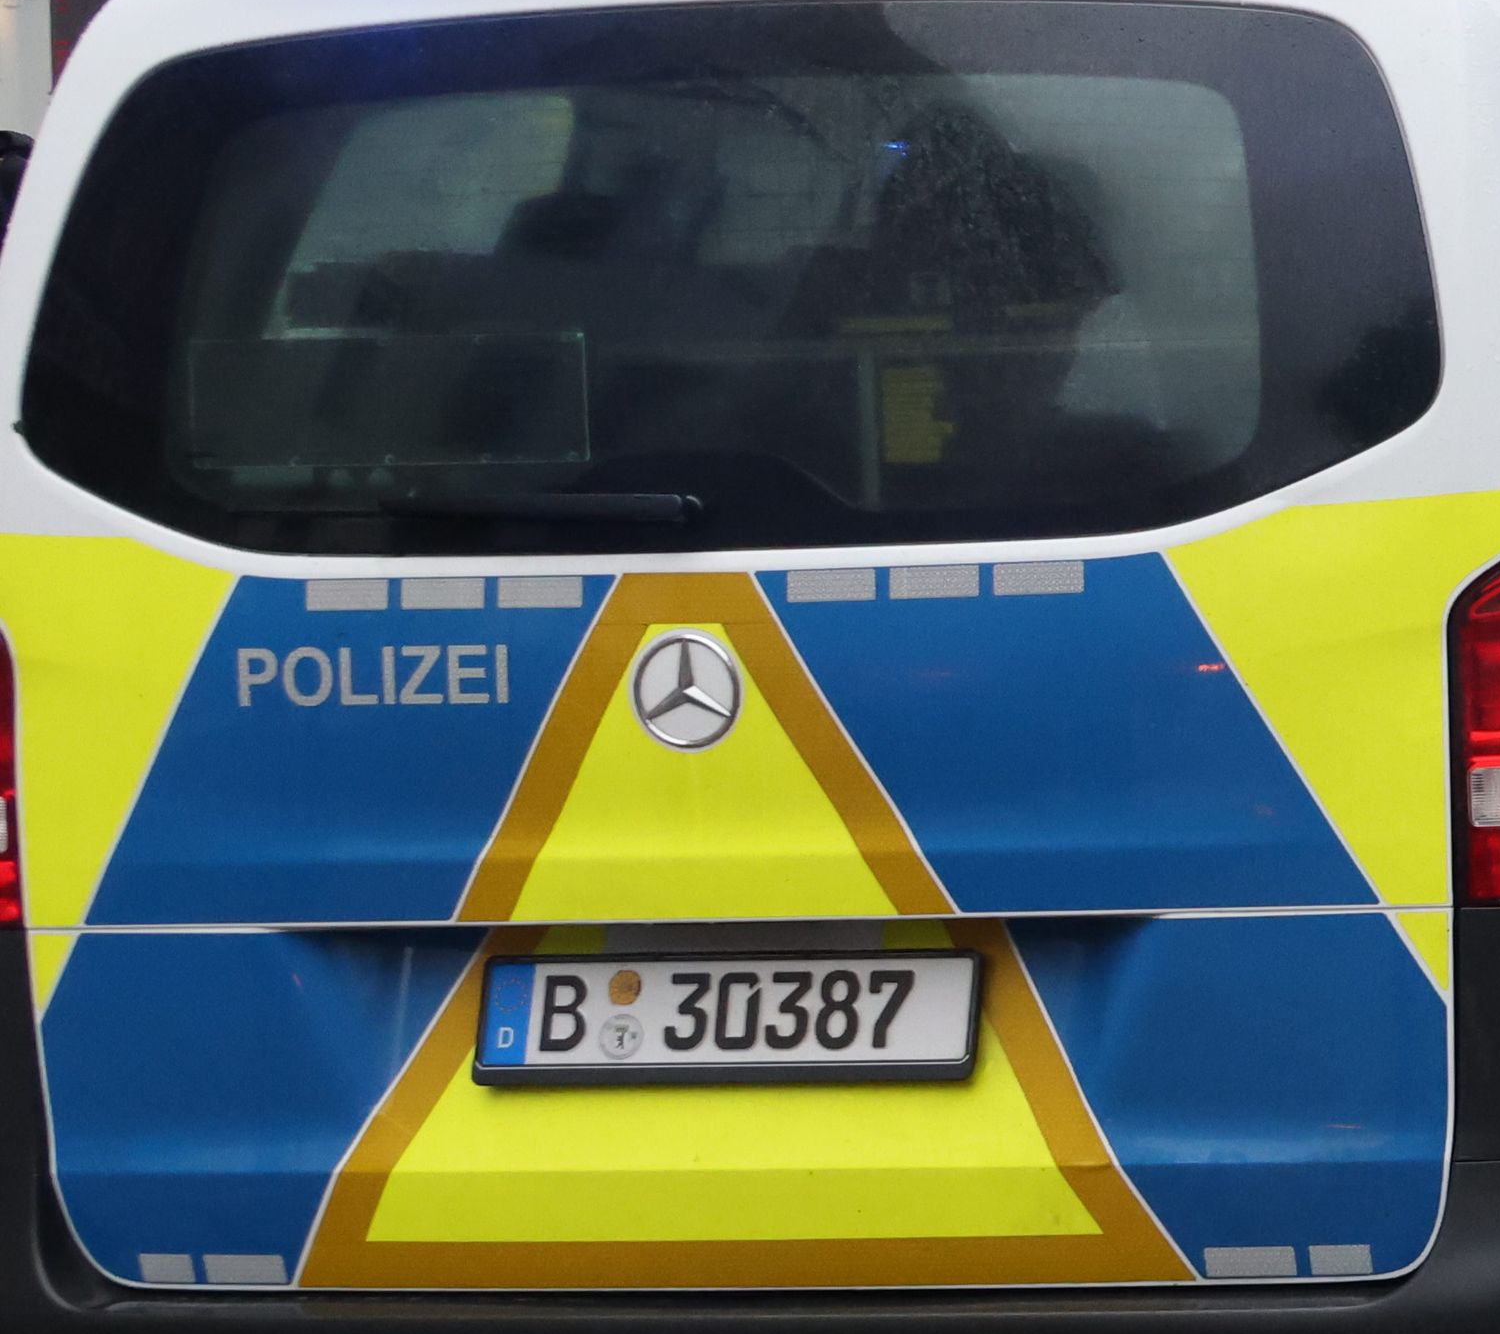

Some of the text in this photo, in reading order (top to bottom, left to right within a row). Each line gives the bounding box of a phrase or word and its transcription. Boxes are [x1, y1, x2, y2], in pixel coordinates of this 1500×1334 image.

[237, 642, 510, 708] POLIZEI
[497, 970, 916, 1053] D B 30387
